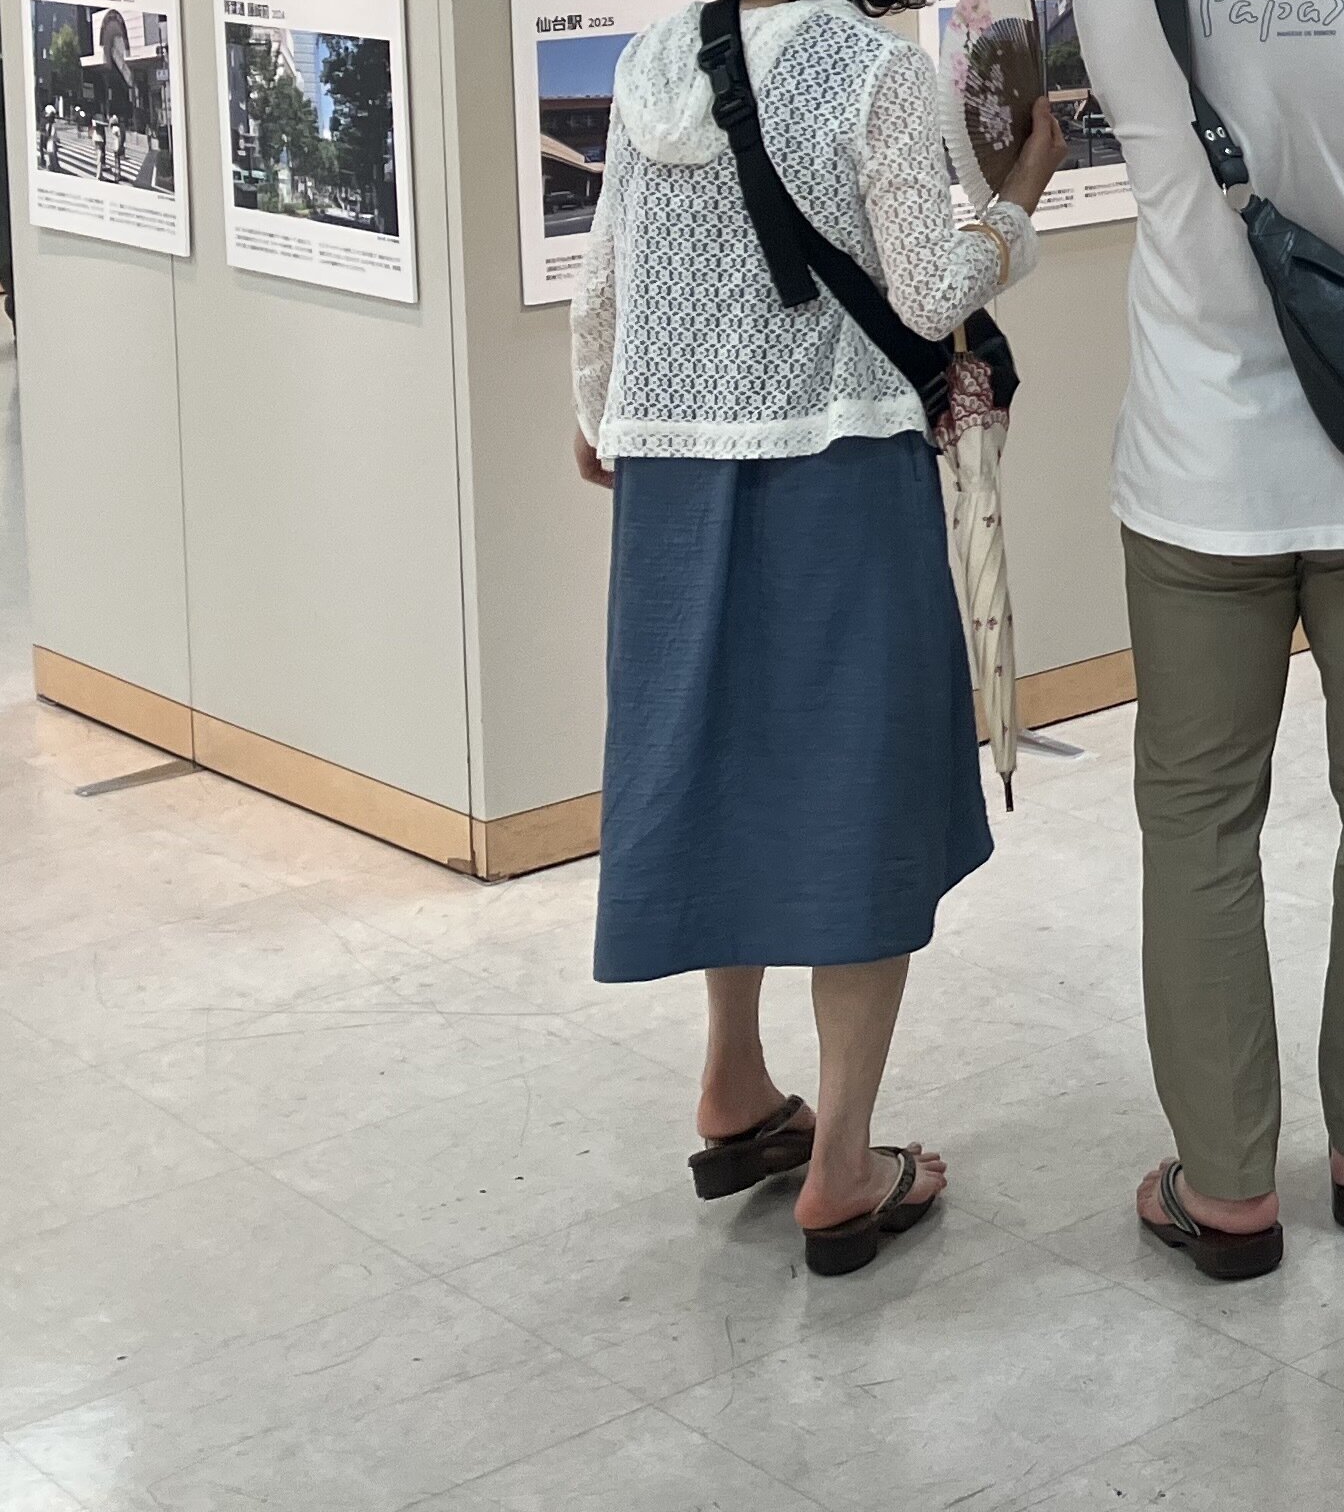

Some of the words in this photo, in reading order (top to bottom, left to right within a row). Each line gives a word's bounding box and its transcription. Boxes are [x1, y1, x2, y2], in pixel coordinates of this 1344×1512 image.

[536, 14, 582, 33] 仙台駅
[588, 16, 615, 28] 2025
